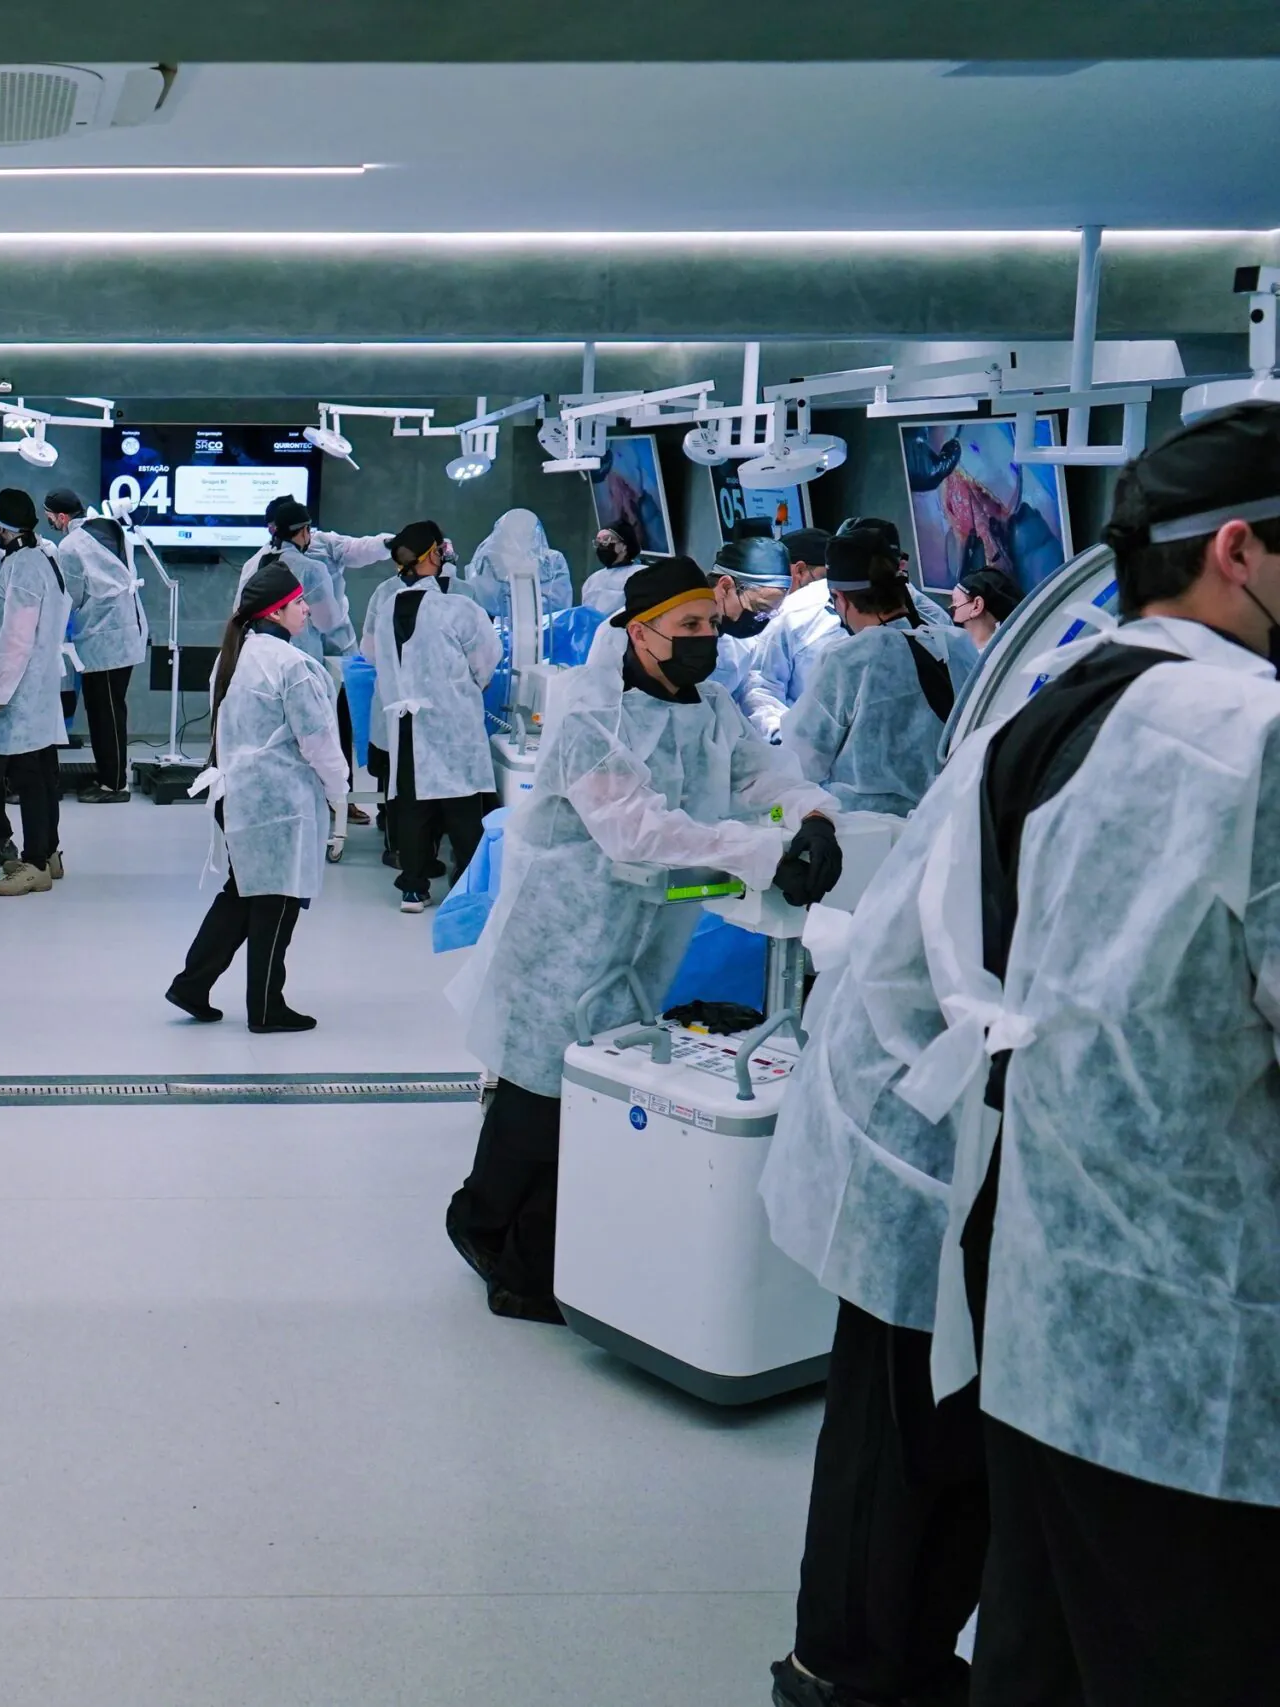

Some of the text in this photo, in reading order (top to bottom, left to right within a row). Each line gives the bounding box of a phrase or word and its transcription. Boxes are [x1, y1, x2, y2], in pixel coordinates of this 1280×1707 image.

[138, 464, 170, 474] ESTAÇÃO
[109, 474, 172, 514] 04
[720, 487, 747, 529] 05
